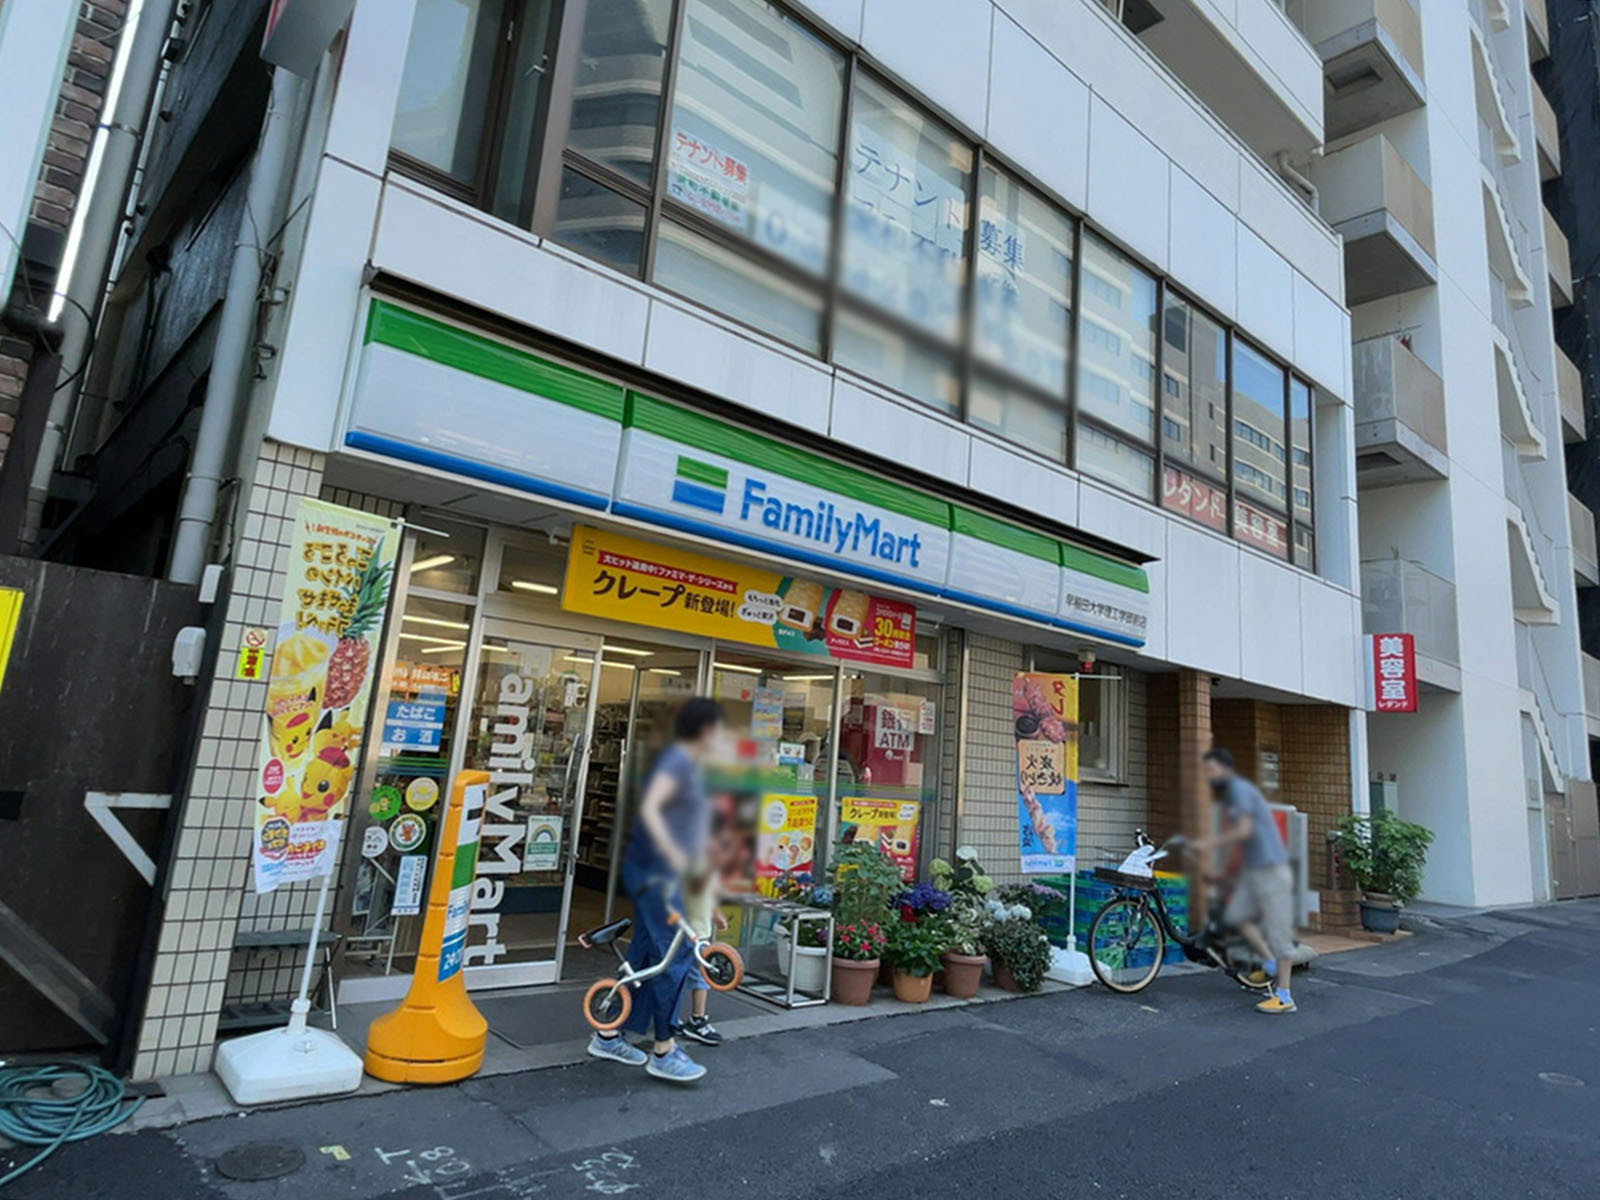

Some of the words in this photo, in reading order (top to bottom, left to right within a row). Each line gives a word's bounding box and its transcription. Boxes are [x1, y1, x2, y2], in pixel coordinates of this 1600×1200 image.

[740, 477, 922, 568] FamilyMart
[1379, 636, 1406, 699] 美容室
[396, 704, 436, 721] たばこ
[879, 732, 910, 748] ATM
